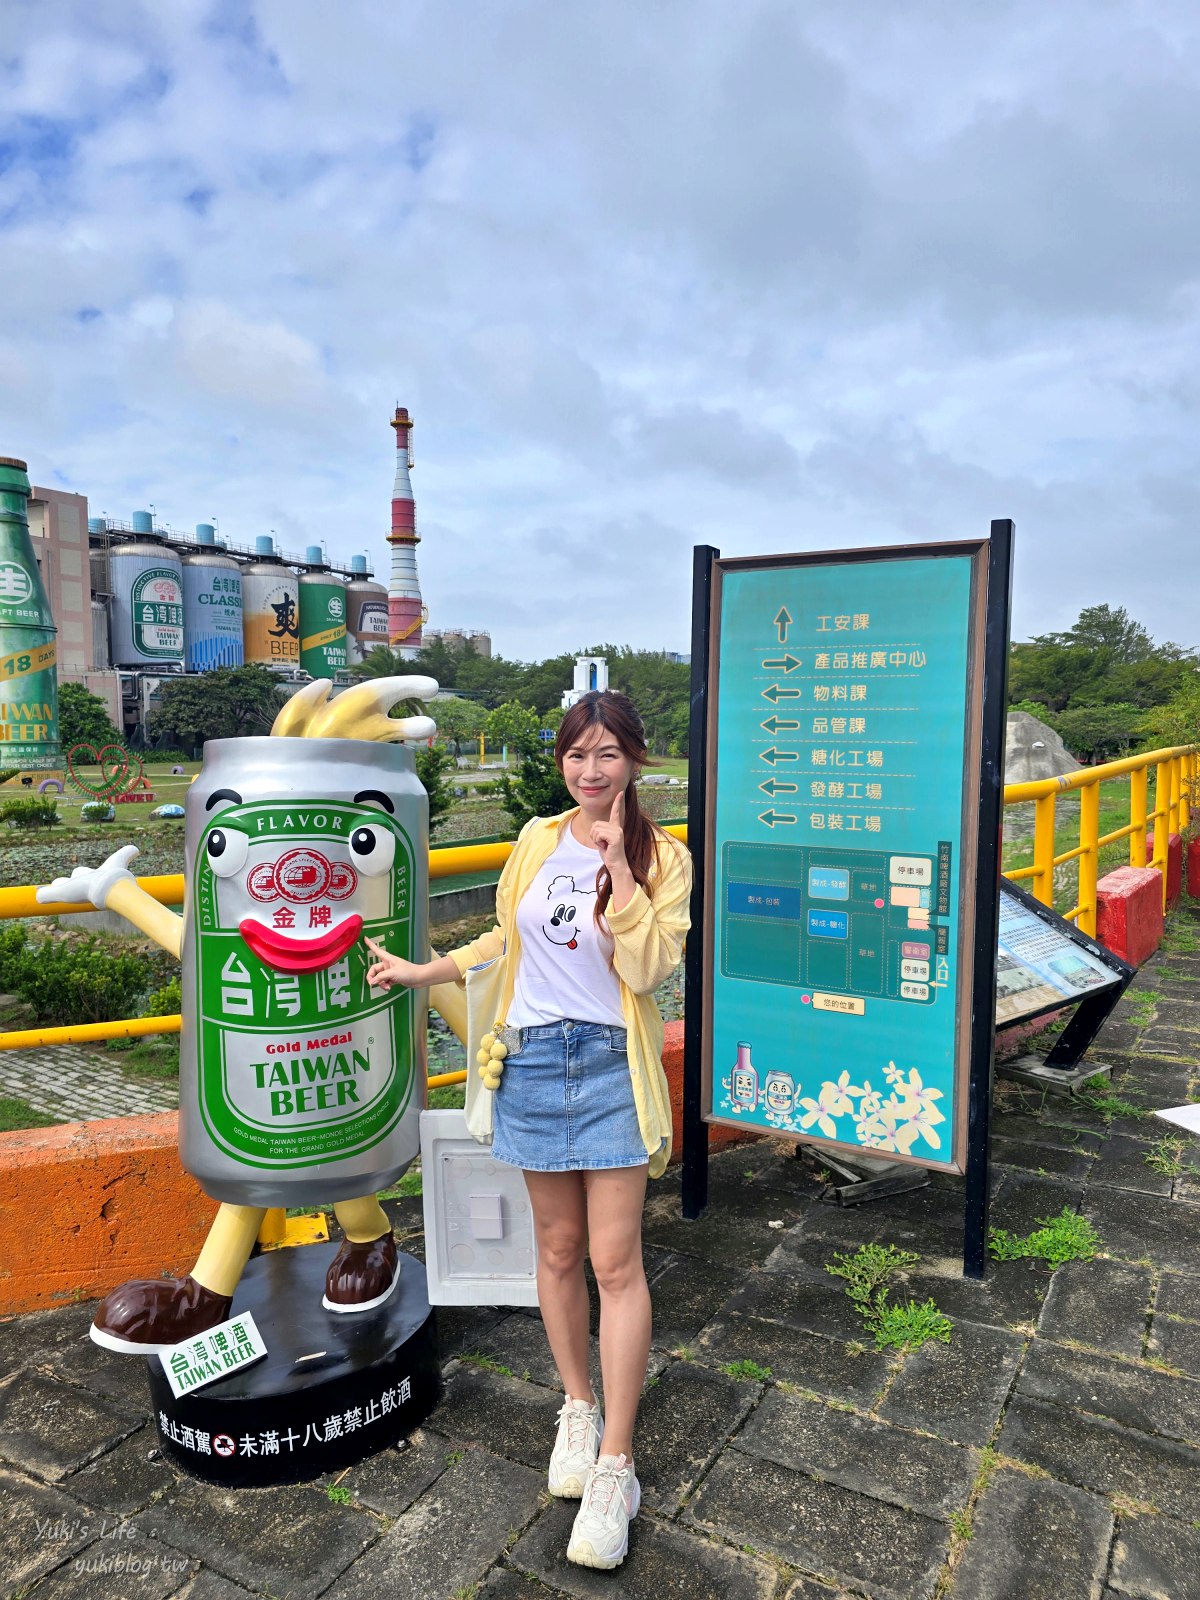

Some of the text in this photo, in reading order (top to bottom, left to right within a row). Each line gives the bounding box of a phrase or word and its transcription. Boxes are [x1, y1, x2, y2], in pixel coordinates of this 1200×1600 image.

[16, 609, 40, 618] BEER
[815, 613, 870, 632] 工安課
[4, 649, 55, 676] 18 DAYS
[814, 650, 926, 670] 產品推廣中心
[813, 685, 868, 702] 物料課
[0, 703, 53, 721] IWAN
[812, 717, 867, 735] 品管課
[810, 749, 884, 768] 糖化工場
[809, 781, 883, 801] 發酵工場
[809, 812, 882, 833] 包裝工場
[256, 814, 343, 831] FLAVOR
[396, 865, 407, 910] BEER
[897, 866, 924, 876] 停車場
[272, 904, 333, 929] 金牌
[903, 965, 928, 976] 停車場
[937, 957, 949, 981] 入口
[823, 998, 855, 1011] 您的位置
[266, 1031, 353, 1055] Gold Medal
[250, 1047, 372, 1089] TAIWAN
[270, 1079, 361, 1117] BEER
[233, 1127, 249, 1139] GOLD
[249, 1134, 269, 1145] MEDAL
[285, 1146, 299, 1154] THE
[301, 1143, 325, 1153] GRAND
[326, 1137, 345, 1148] GOLD
[345, 1130, 366, 1142] MEDAL
[174, 1341, 256, 1391] TAIWAN BEER
[158, 1375, 412, 1458] 禁止酒駕 未滿十八歲禁止飲酒
